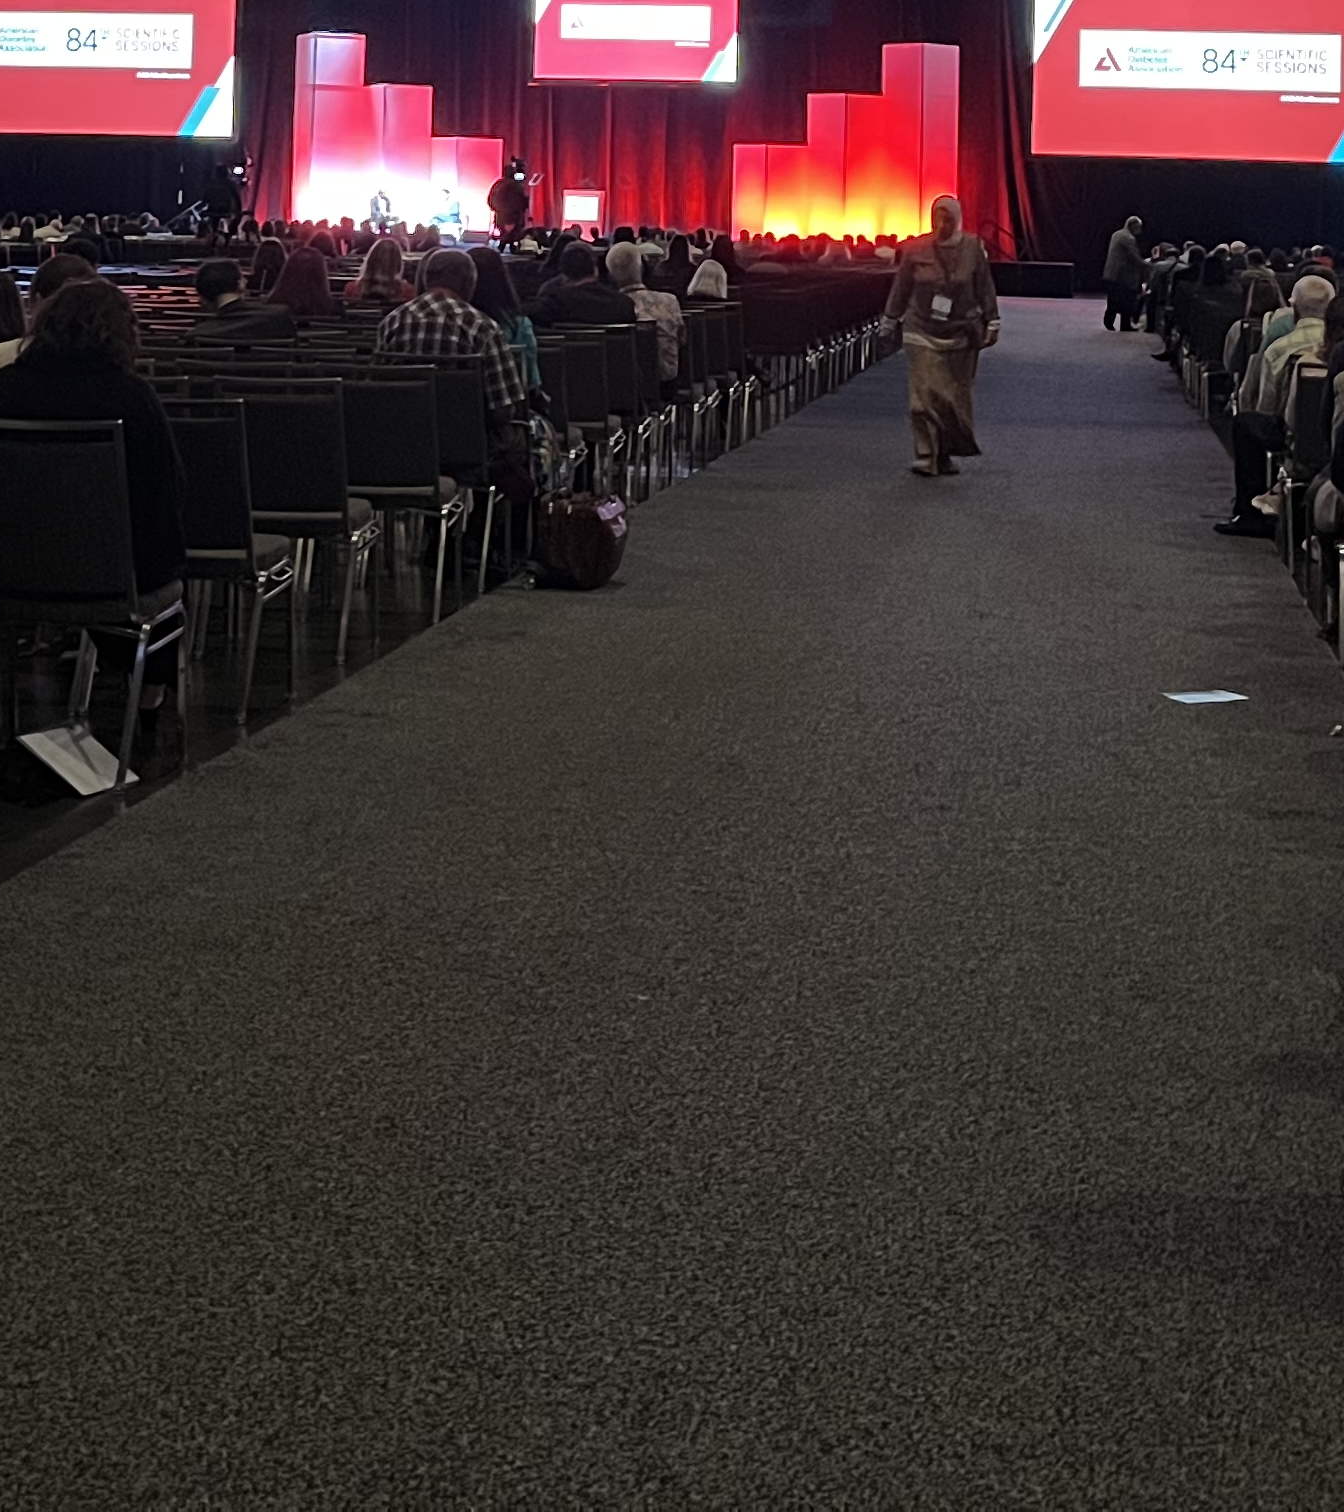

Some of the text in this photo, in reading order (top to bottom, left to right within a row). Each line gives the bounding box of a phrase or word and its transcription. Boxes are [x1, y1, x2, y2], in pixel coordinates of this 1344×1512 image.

[115, 40, 179, 52] SESSIONS
[1257, 48, 1328, 61] SCIENTIFIC
[1256, 61, 1327, 74] SESSIONS
